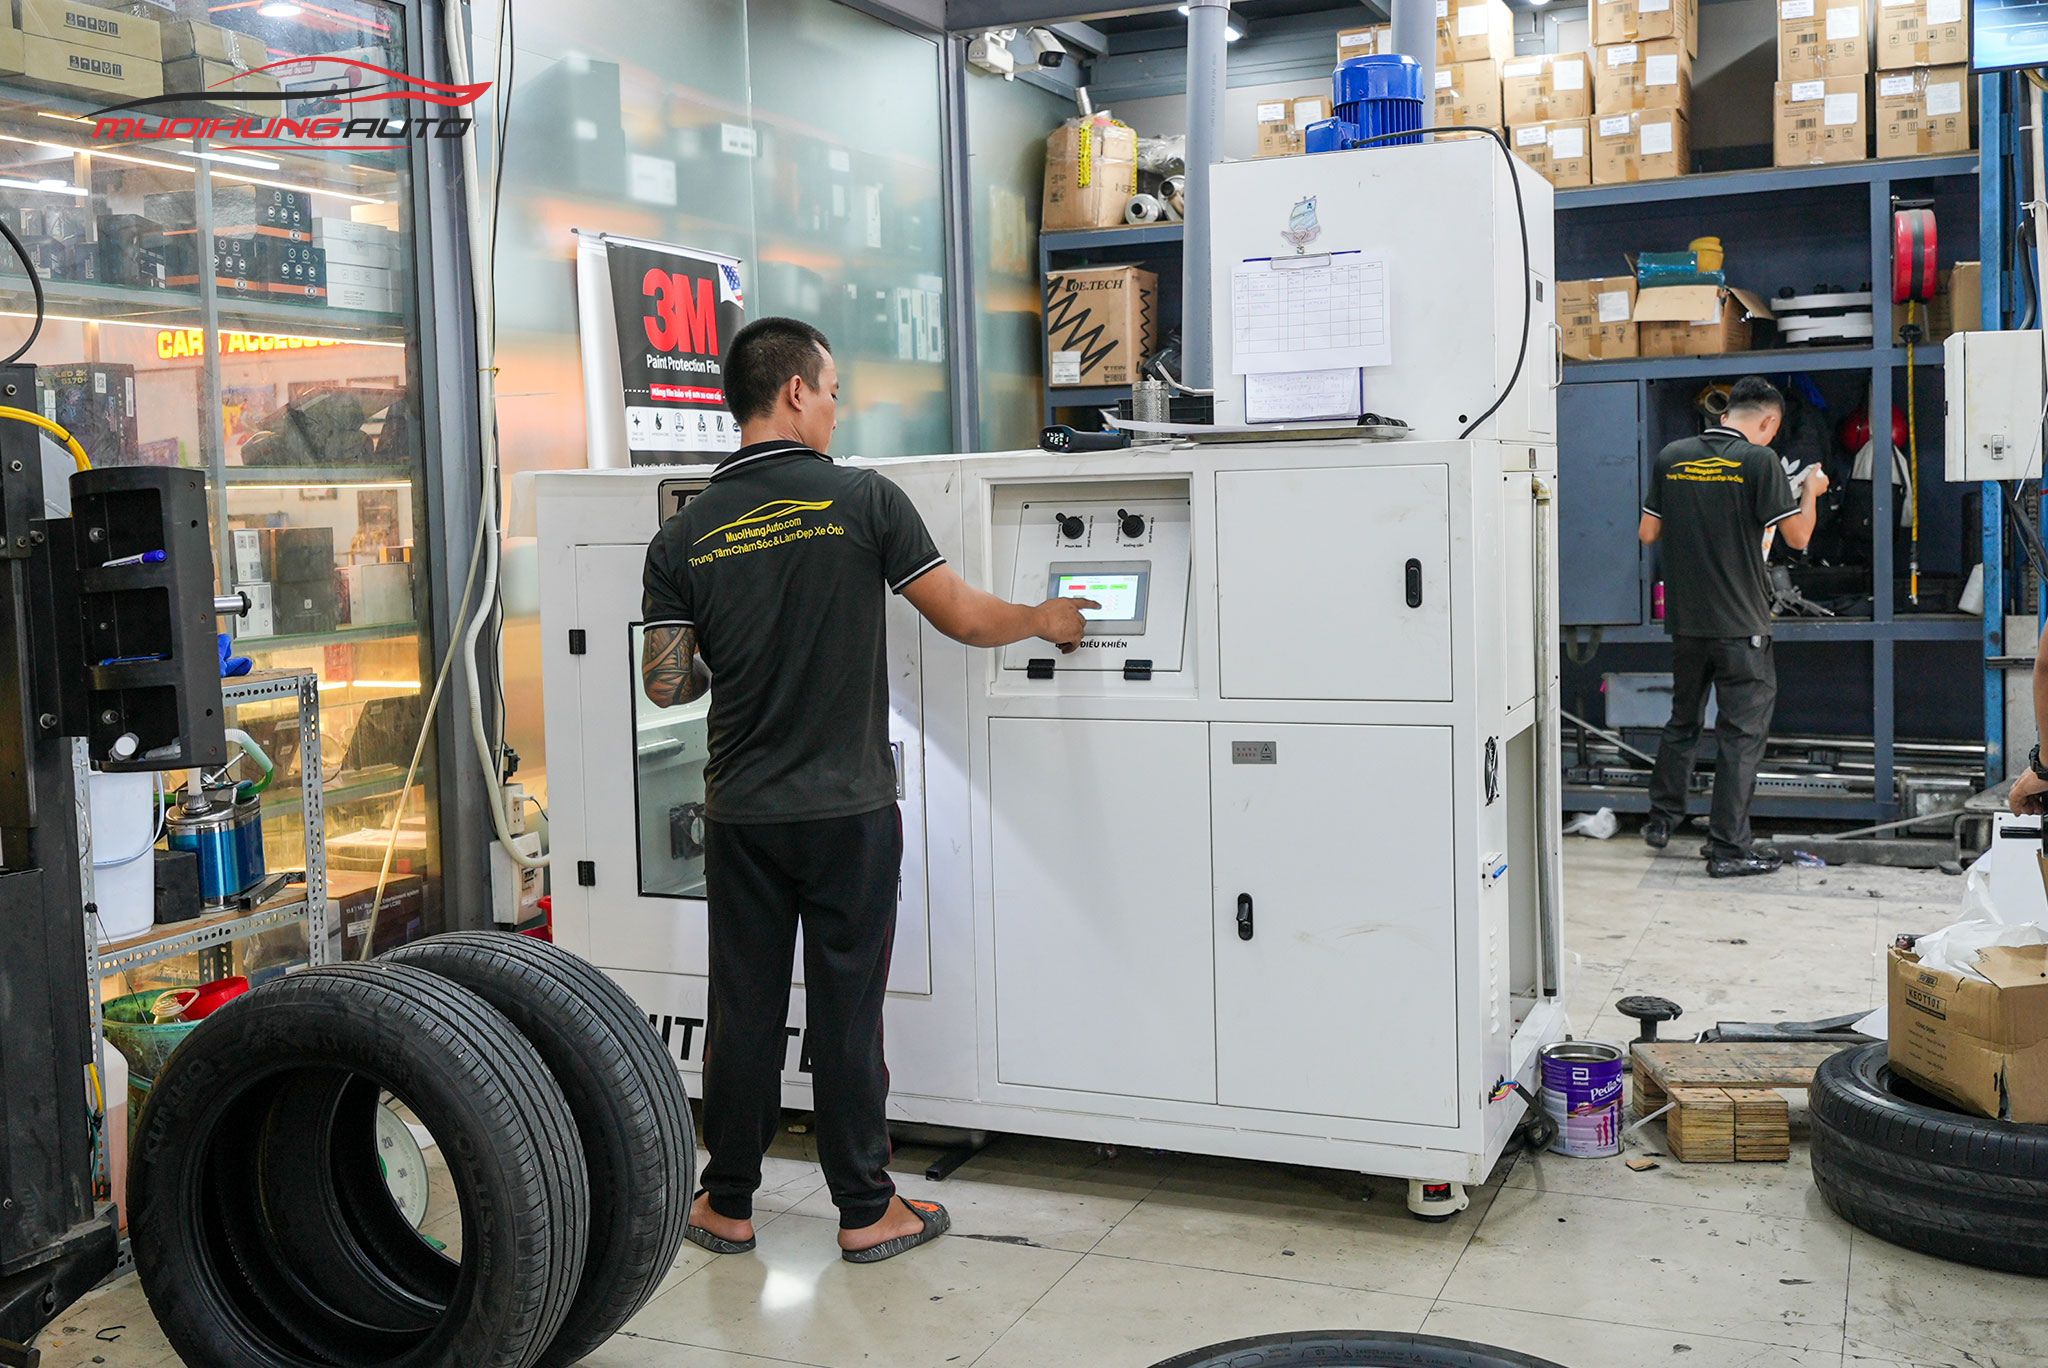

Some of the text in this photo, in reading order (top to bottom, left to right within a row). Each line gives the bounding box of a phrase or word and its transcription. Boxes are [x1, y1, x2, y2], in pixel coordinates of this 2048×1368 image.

[643, 267, 719, 356] 3M
[646, 353, 720, 374] Paint Protection Film
[688, 551, 714, 567] Trung
[814, 526, 826, 536] Xe
[381, 1136, 394, 1149] 20
[398, 1167, 408, 1179] 30
